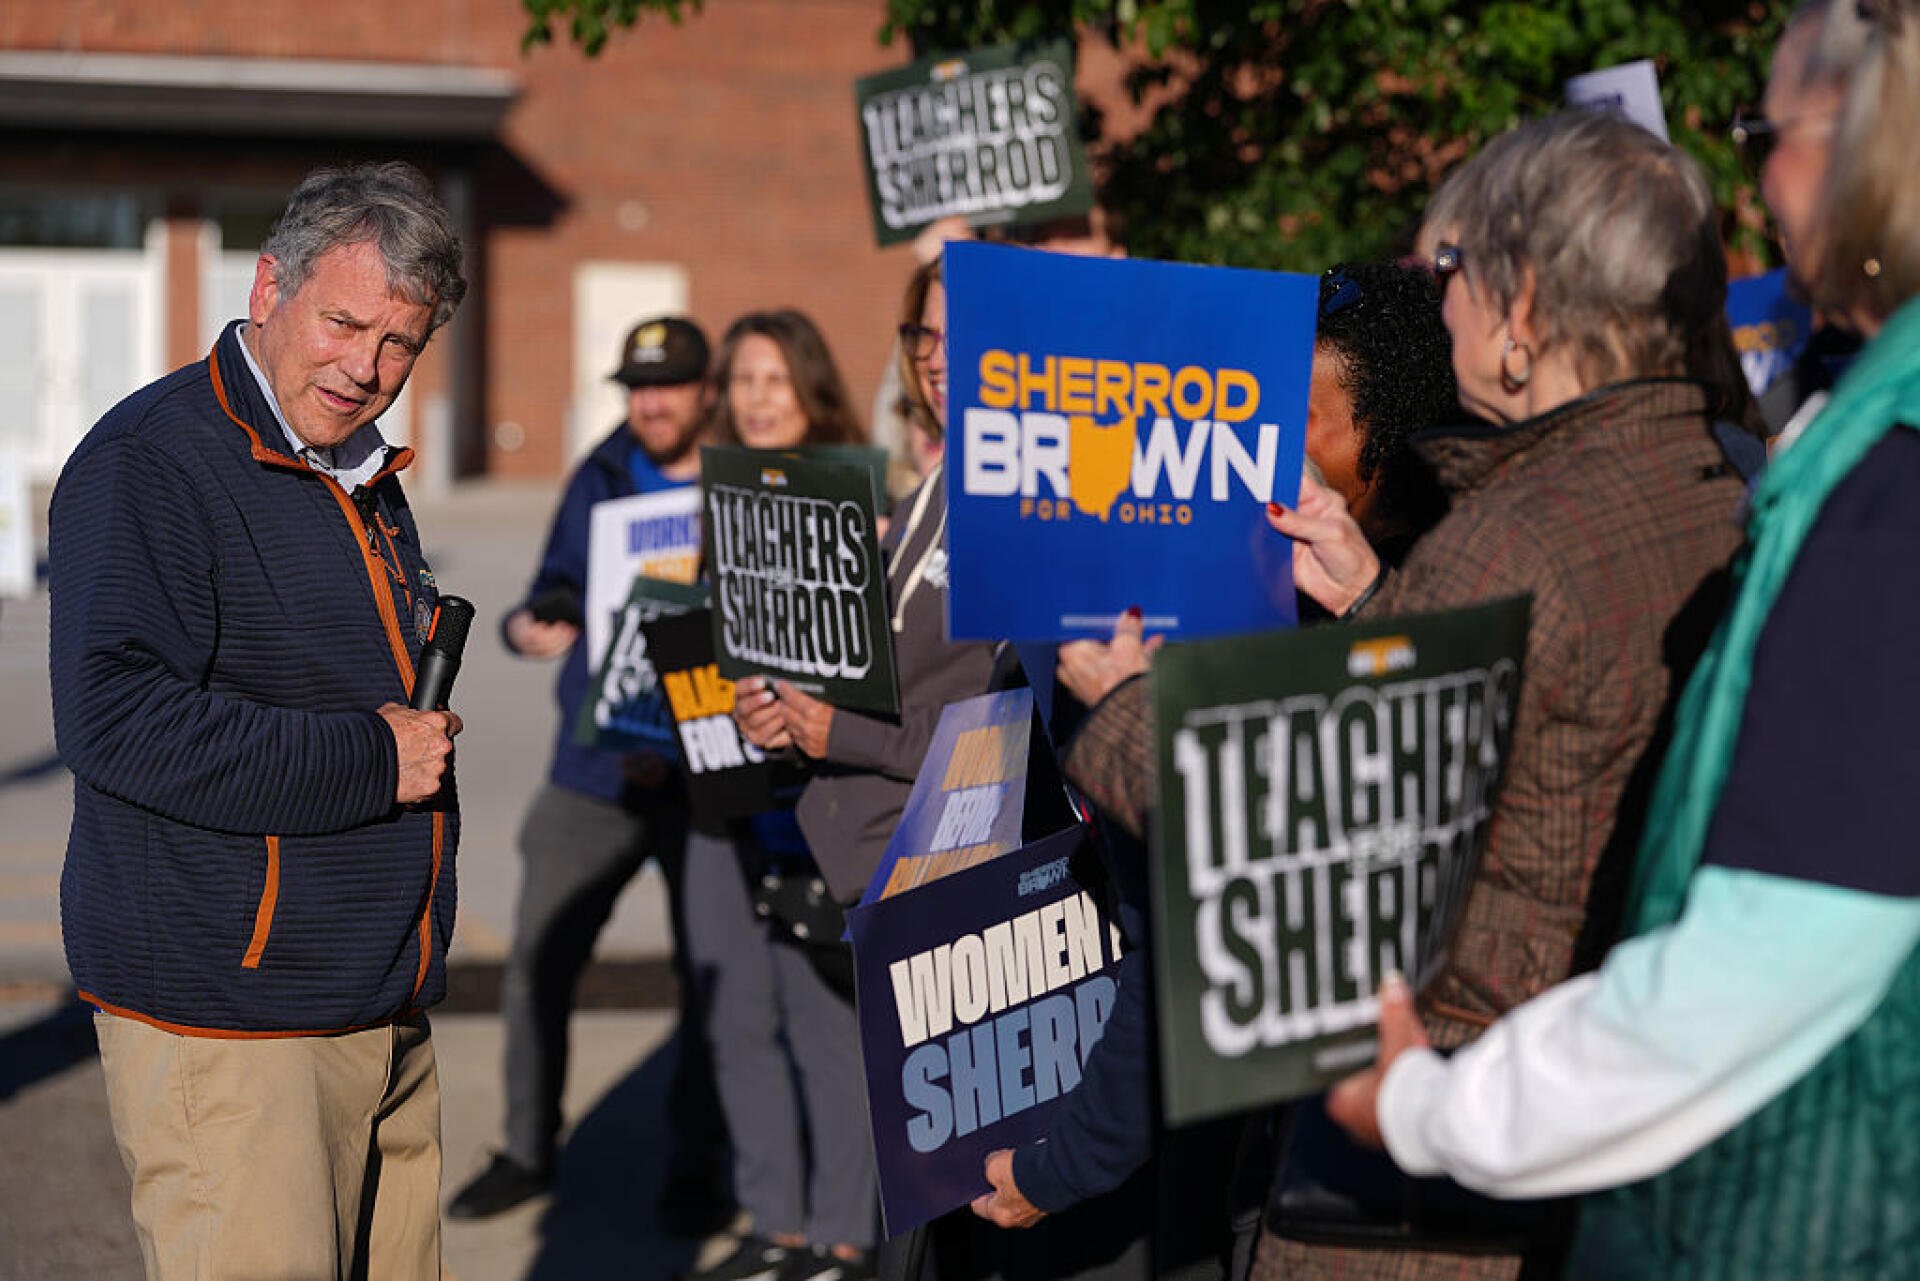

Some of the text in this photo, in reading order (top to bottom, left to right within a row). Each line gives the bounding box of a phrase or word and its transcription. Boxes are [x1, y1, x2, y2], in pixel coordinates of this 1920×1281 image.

[978, 349, 1261, 423] SHERROD
[709, 483, 870, 592] TEACHERS
[1020, 499, 1193, 525] FOR OHIO
[718, 568, 874, 680] SHERROD
[889, 890, 1103, 1048] WOMEN
[1197, 832, 1470, 1058] SHER
[902, 976, 1119, 1154] SHERR
